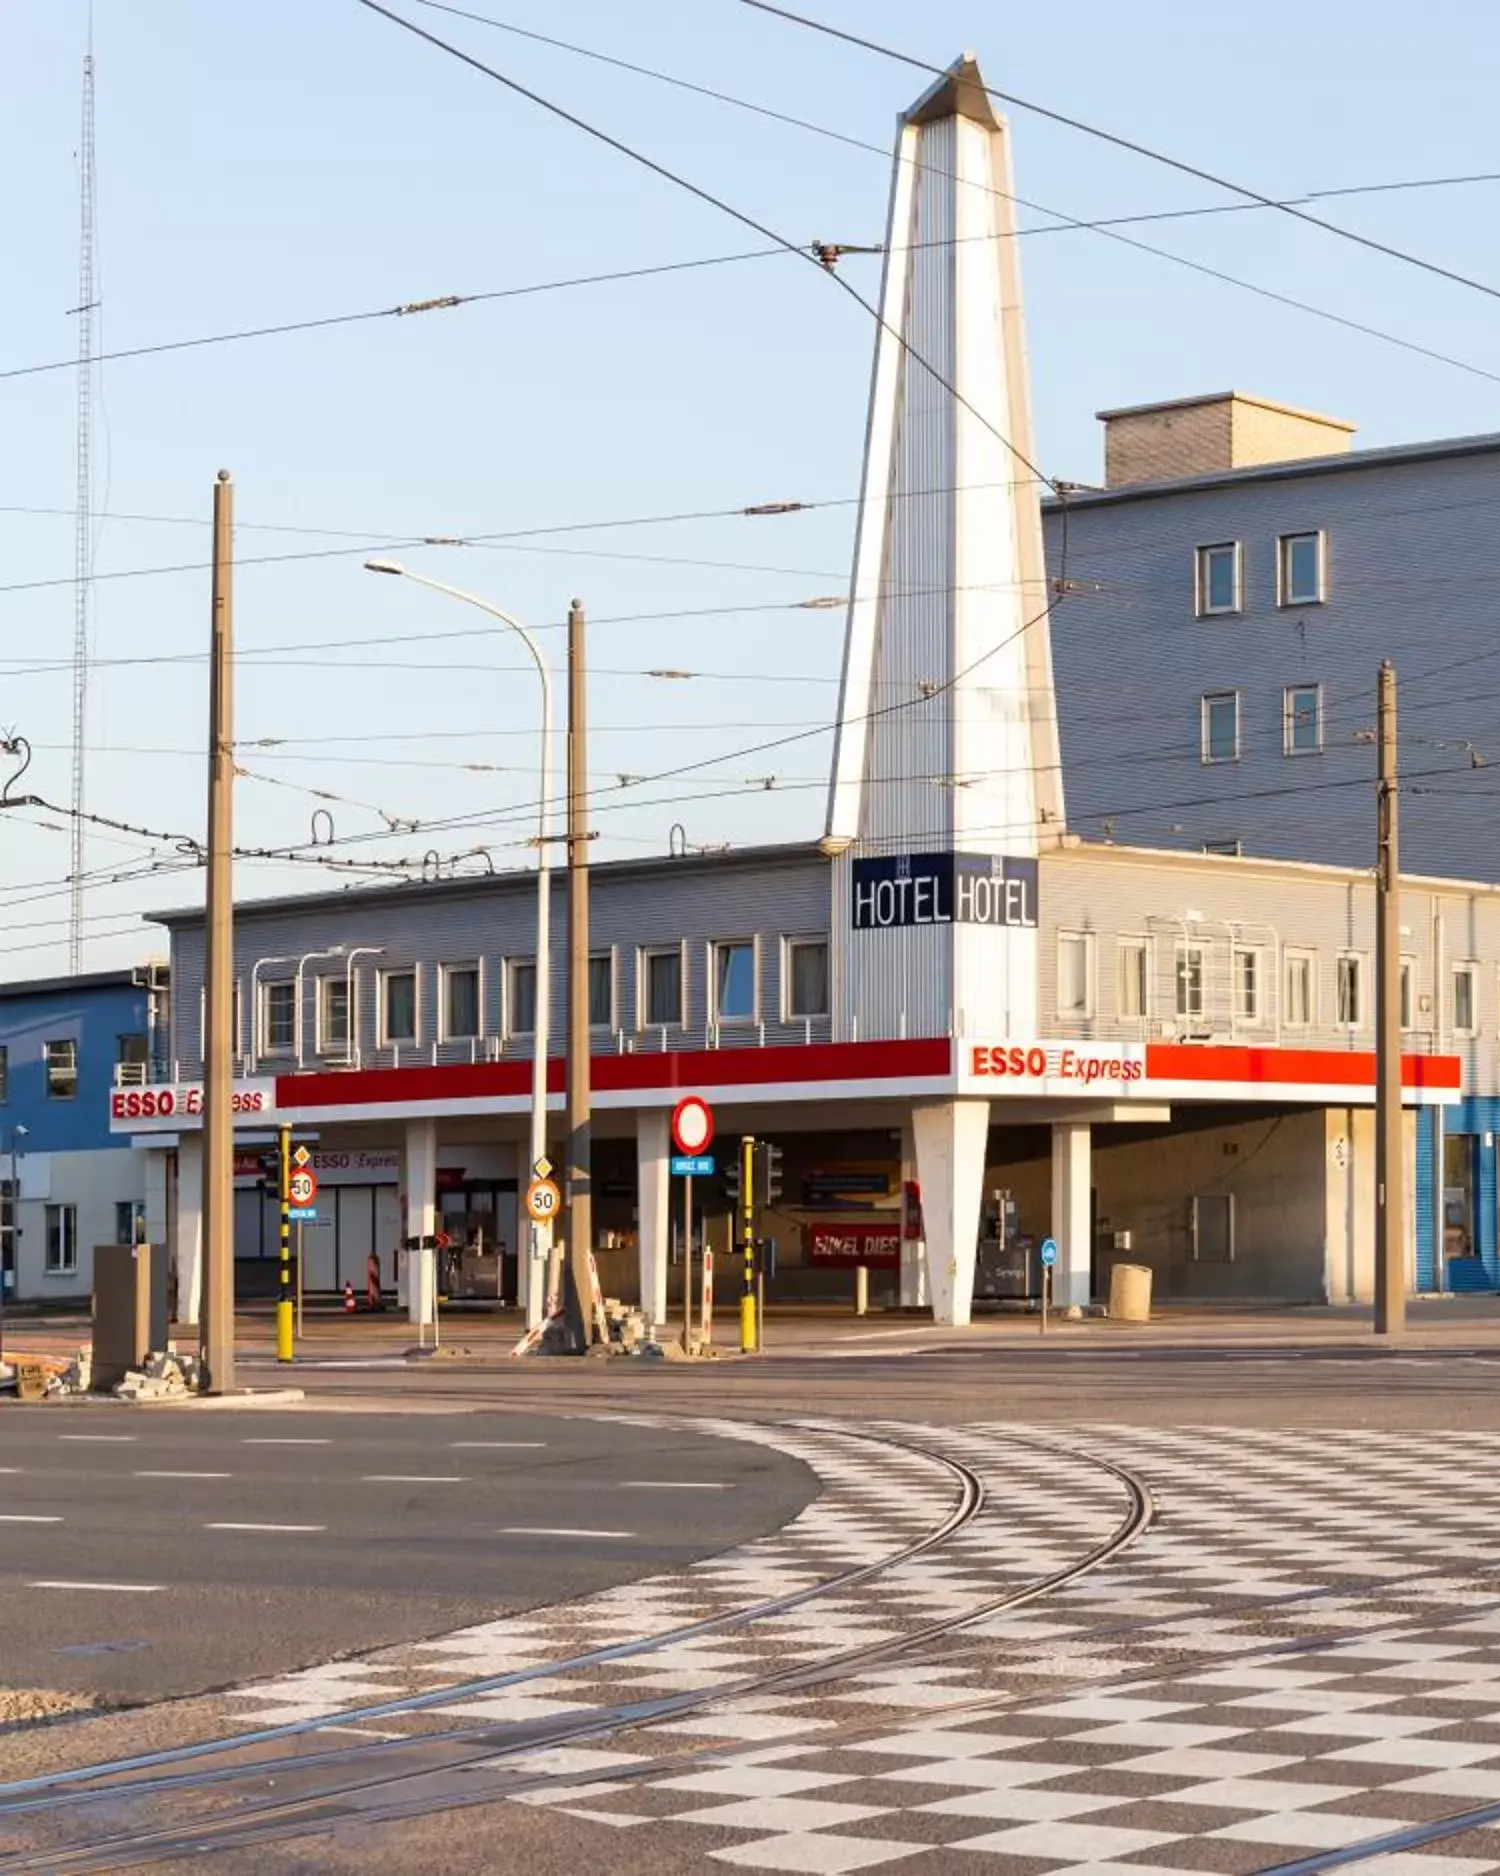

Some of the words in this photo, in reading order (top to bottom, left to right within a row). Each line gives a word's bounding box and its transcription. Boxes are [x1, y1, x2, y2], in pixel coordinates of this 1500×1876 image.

[856, 875, 951, 926] HOTEL
[957, 875, 1035, 926] HOTEL
[973, 1047, 1046, 1076] ESSO
[1060, 1050, 1142, 1084] Express
[112, 1091, 174, 1118] ESSO
[187, 1090, 262, 1113] Eess
[313, 1154, 349, 1169] ESSO
[292, 1179, 311, 1195] 50
[534, 1191, 553, 1209] 50
